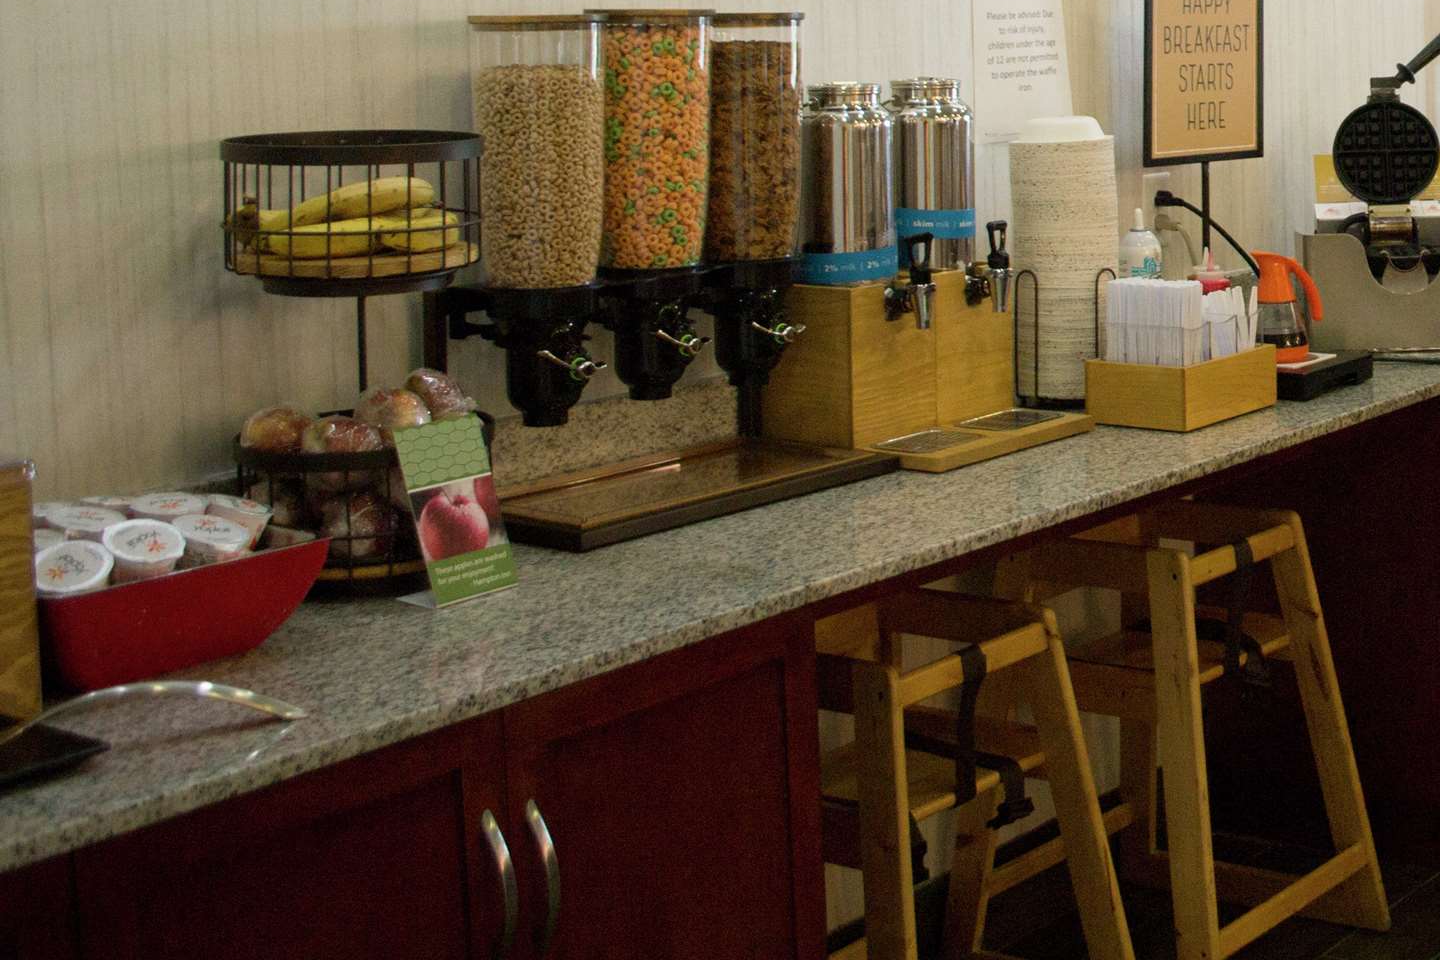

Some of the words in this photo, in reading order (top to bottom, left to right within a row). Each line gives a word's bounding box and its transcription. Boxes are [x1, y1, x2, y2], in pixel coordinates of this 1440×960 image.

[986, 10, 1007, 20] Please
[1008, 11, 1017, 19] be
[1042, 8, 1055, 18] Due
[998, 26, 1006, 35] to
[987, 41, 1015, 51] children
[1016, 40, 1033, 49] under
[1034, 39, 1045, 47] the
[1046, 39, 1056, 49] age
[1163, 24, 1250, 55] BREAKFAST
[986, 55, 995, 65] of
[996, 55, 1005, 65] 12
[1006, 56, 1017, 64] are
[1018, 55, 1029, 63] not
[1030, 52, 1058, 63] permitted
[991, 71, 999, 80] to
[1000, 69, 1025, 80] operate
[1026, 68, 1037, 77] the
[1178, 62, 1234, 93] STARTS
[1187, 100, 1227, 131] HERE
[912, 219, 934, 228] skim
[824, 264, 839, 273] 2%
[866, 260, 879, 270] 2%
